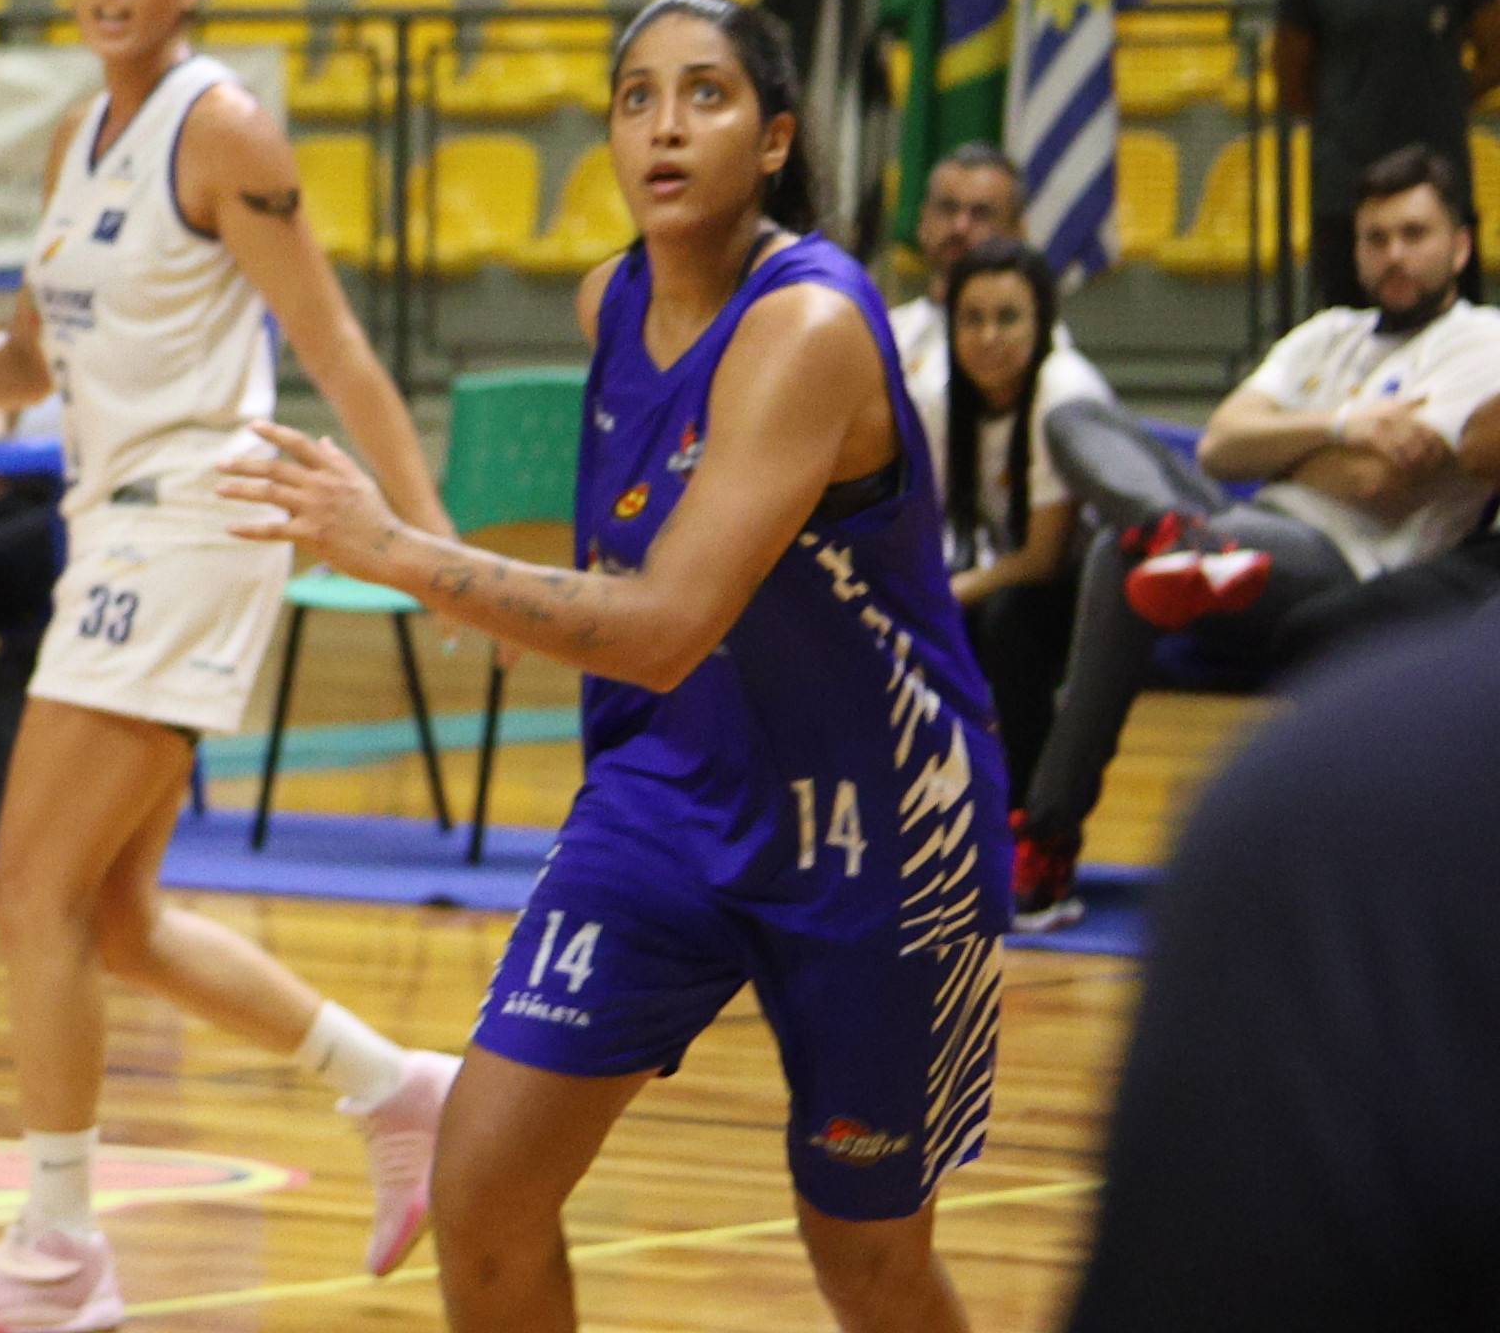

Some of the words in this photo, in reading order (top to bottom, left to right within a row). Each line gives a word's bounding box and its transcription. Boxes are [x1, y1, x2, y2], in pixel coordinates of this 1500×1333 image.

[78, 583, 139, 646] 33
[790, 777, 869, 878] 14
[527, 909, 604, 994] 14
